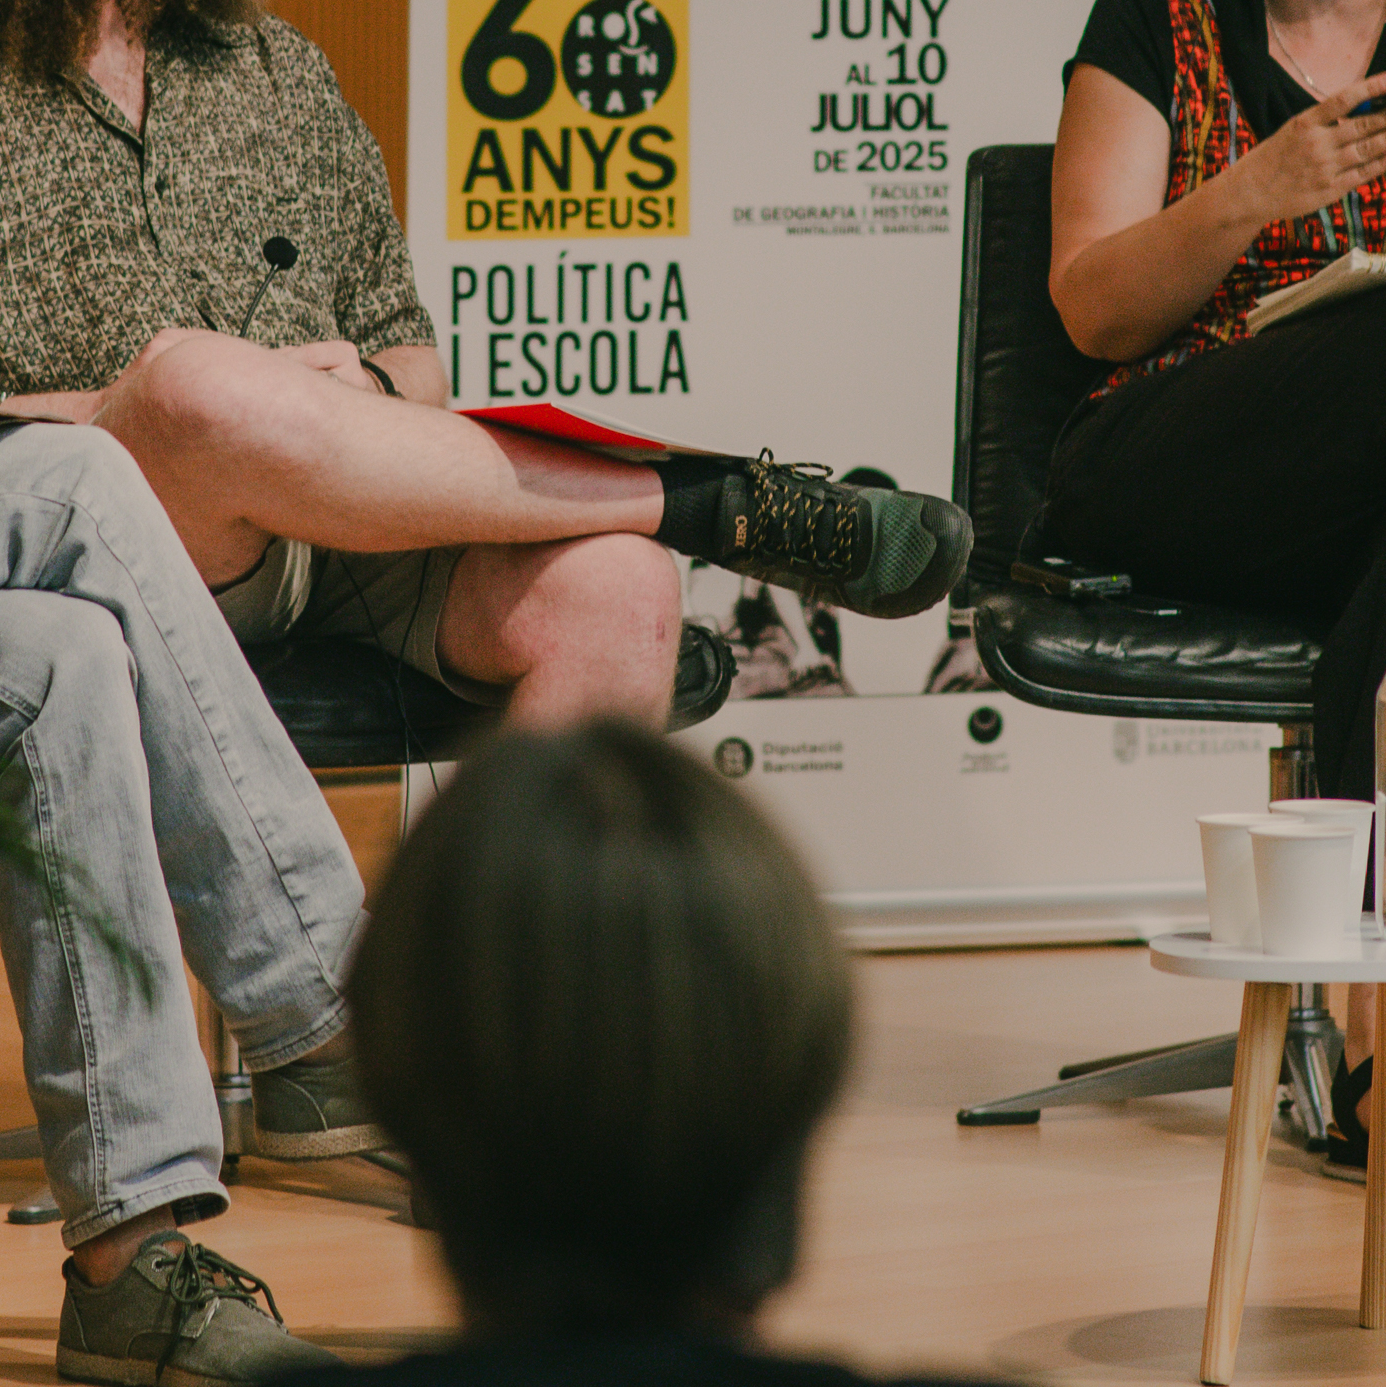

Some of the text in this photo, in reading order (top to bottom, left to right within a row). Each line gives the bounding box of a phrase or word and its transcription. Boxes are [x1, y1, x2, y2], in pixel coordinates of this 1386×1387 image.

[845, 42, 948, 86] AL 10
[811, 92, 949, 133] JULIOL
[462, 124, 677, 194] ANYS
[814, 141, 949, 173] DE 2025
[870, 184, 950, 200] FACULTAT
[466, 196, 675, 231] DEMPEUS!
[733, 207, 753, 221] DE
[452, 250, 688, 326] POLÍTICA
[452, 329, 689, 398] I ESCOLA
